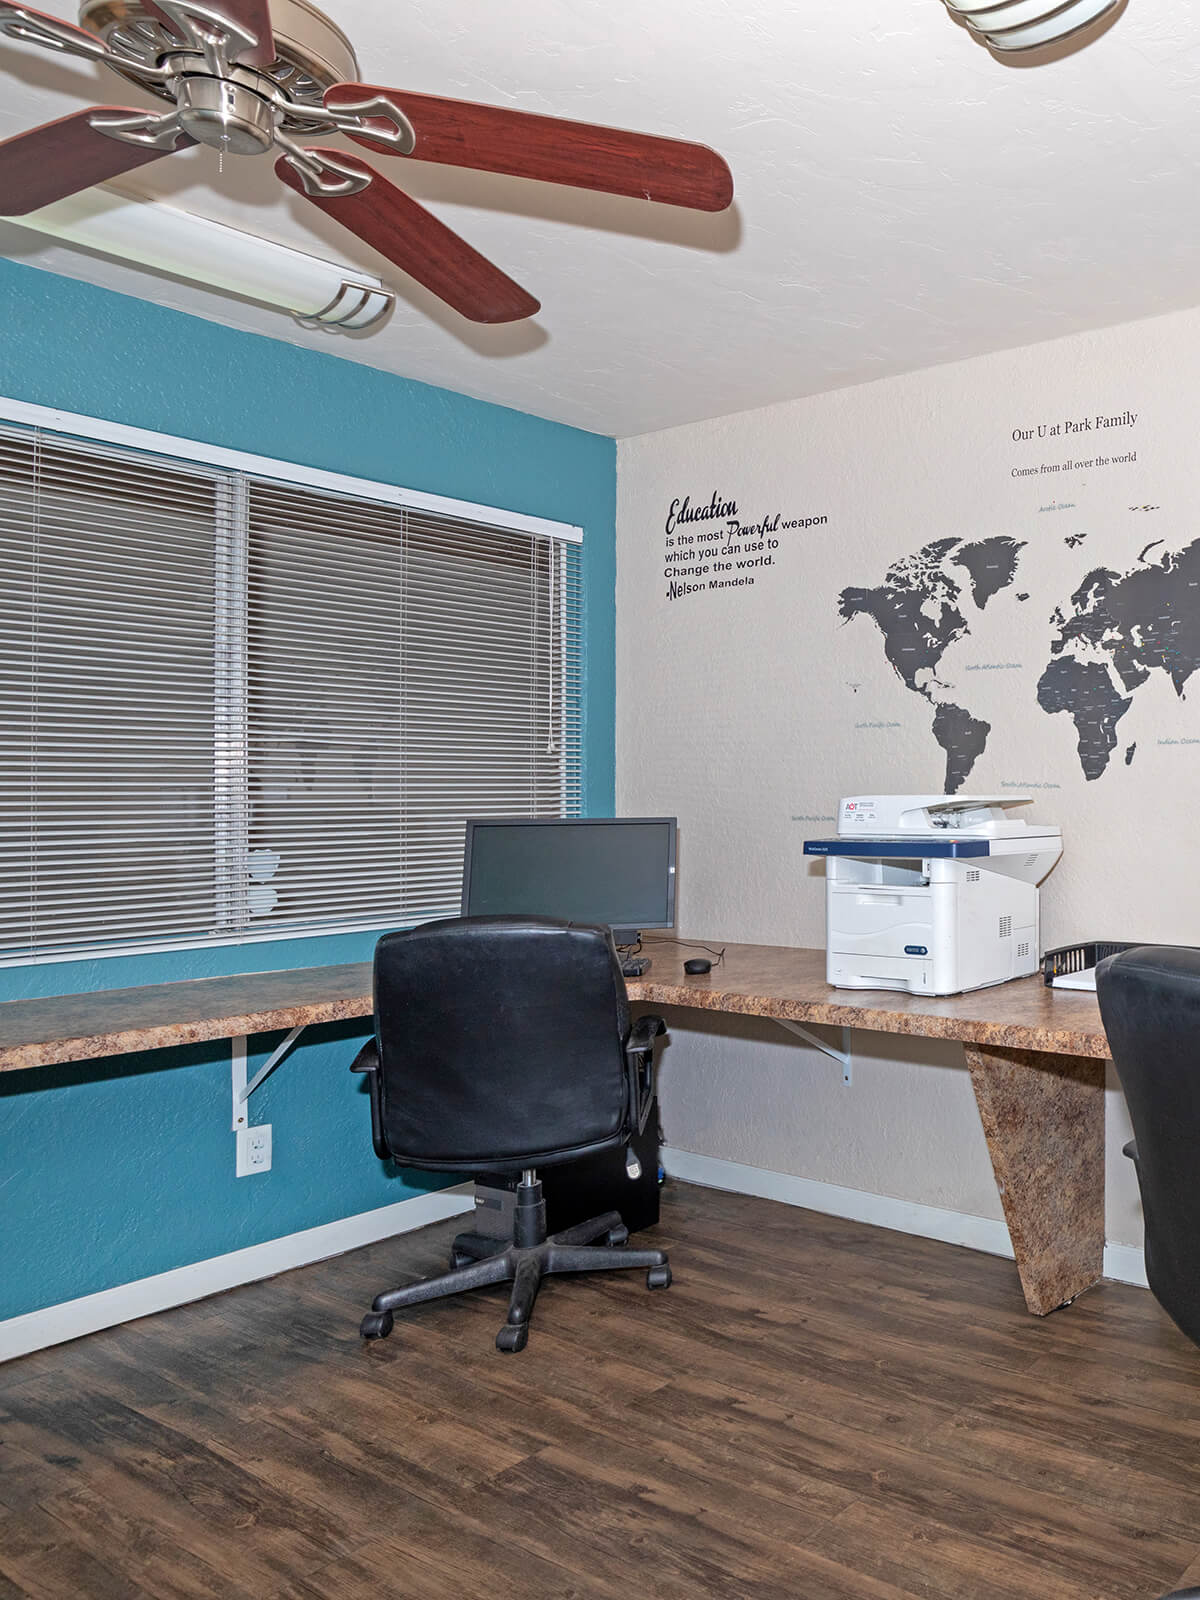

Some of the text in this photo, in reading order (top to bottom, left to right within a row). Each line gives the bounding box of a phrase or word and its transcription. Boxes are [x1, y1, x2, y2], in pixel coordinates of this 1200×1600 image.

[1012, 410, 1138, 441] Our U at Park Family
[1011, 451, 1137, 478] Comes from all over the world
[665, 490, 738, 535] Education
[665, 513, 828, 547] is the most Powerful weapon
[664, 538, 779, 563] which you can use to
[664, 555, 776, 578] Change the world.
[708, 576, 755, 590] Mandela
